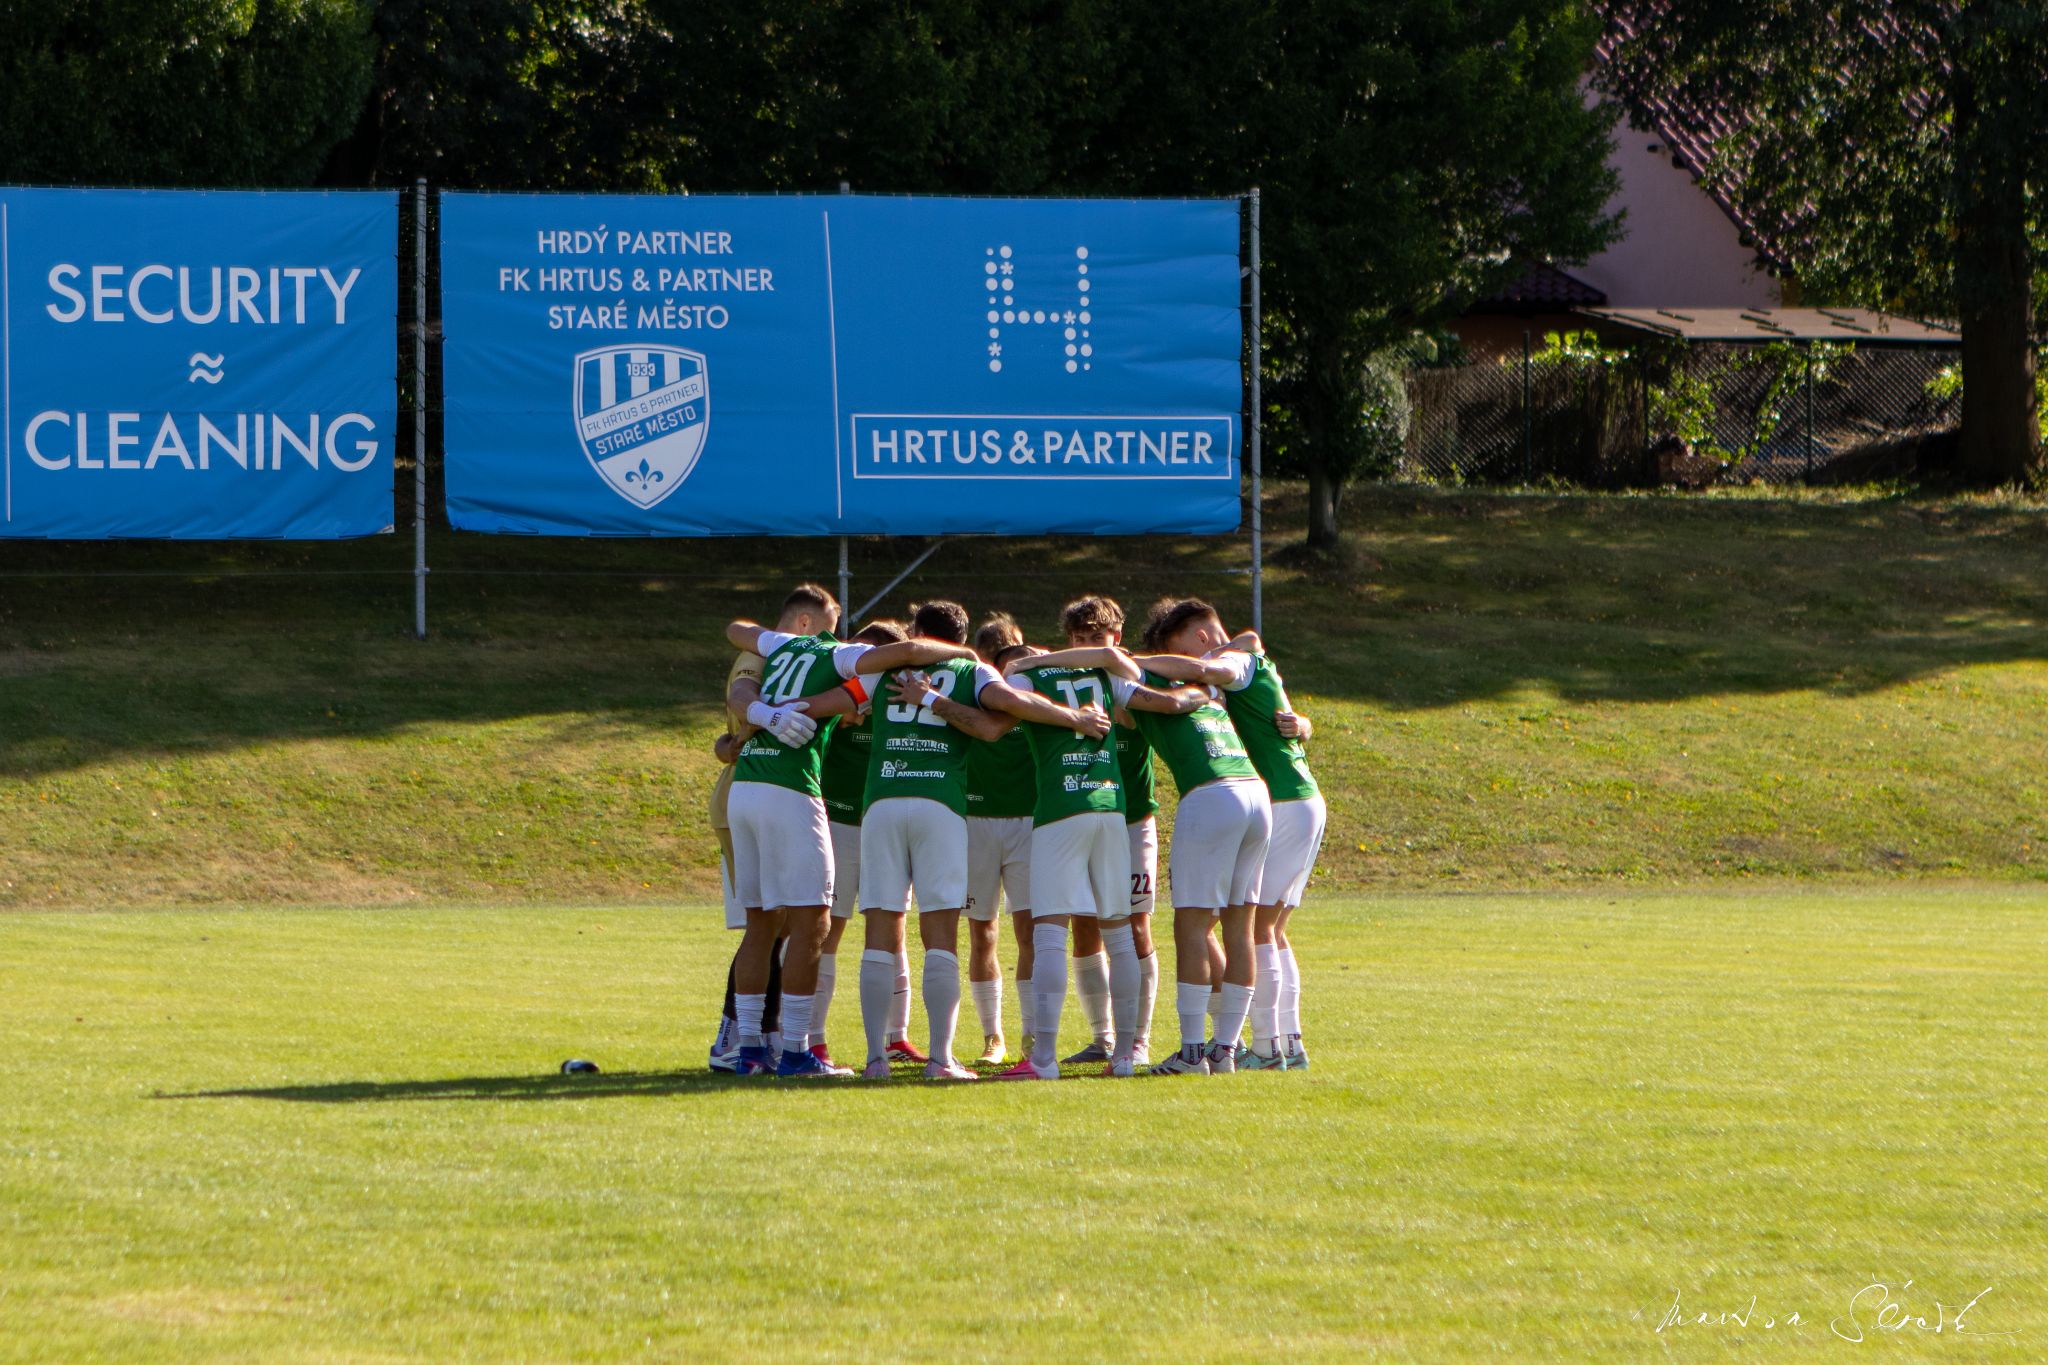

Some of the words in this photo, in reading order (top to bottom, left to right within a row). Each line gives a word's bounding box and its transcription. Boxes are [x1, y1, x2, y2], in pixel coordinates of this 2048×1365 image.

[538, 224, 609, 254] HRDÝ
[617, 231, 733, 254] PARTNER
[46, 263, 361, 324] SECURITY
[500, 268, 530, 292] FK
[539, 268, 623, 292] HRTUS
[632, 268, 650, 292] &
[659, 268, 774, 292] PARTNER
[549, 299, 628, 330] STARÉ
[637, 298, 729, 330] MĚSTO
[602, 407, 639, 428] HRTUS
[650, 383, 699, 412] PARTNER
[25, 410, 378, 472] CLEANING
[760, 651, 817, 705] 20
[1056, 677, 1105, 740] 17
[1131, 873, 1153, 895] 22
